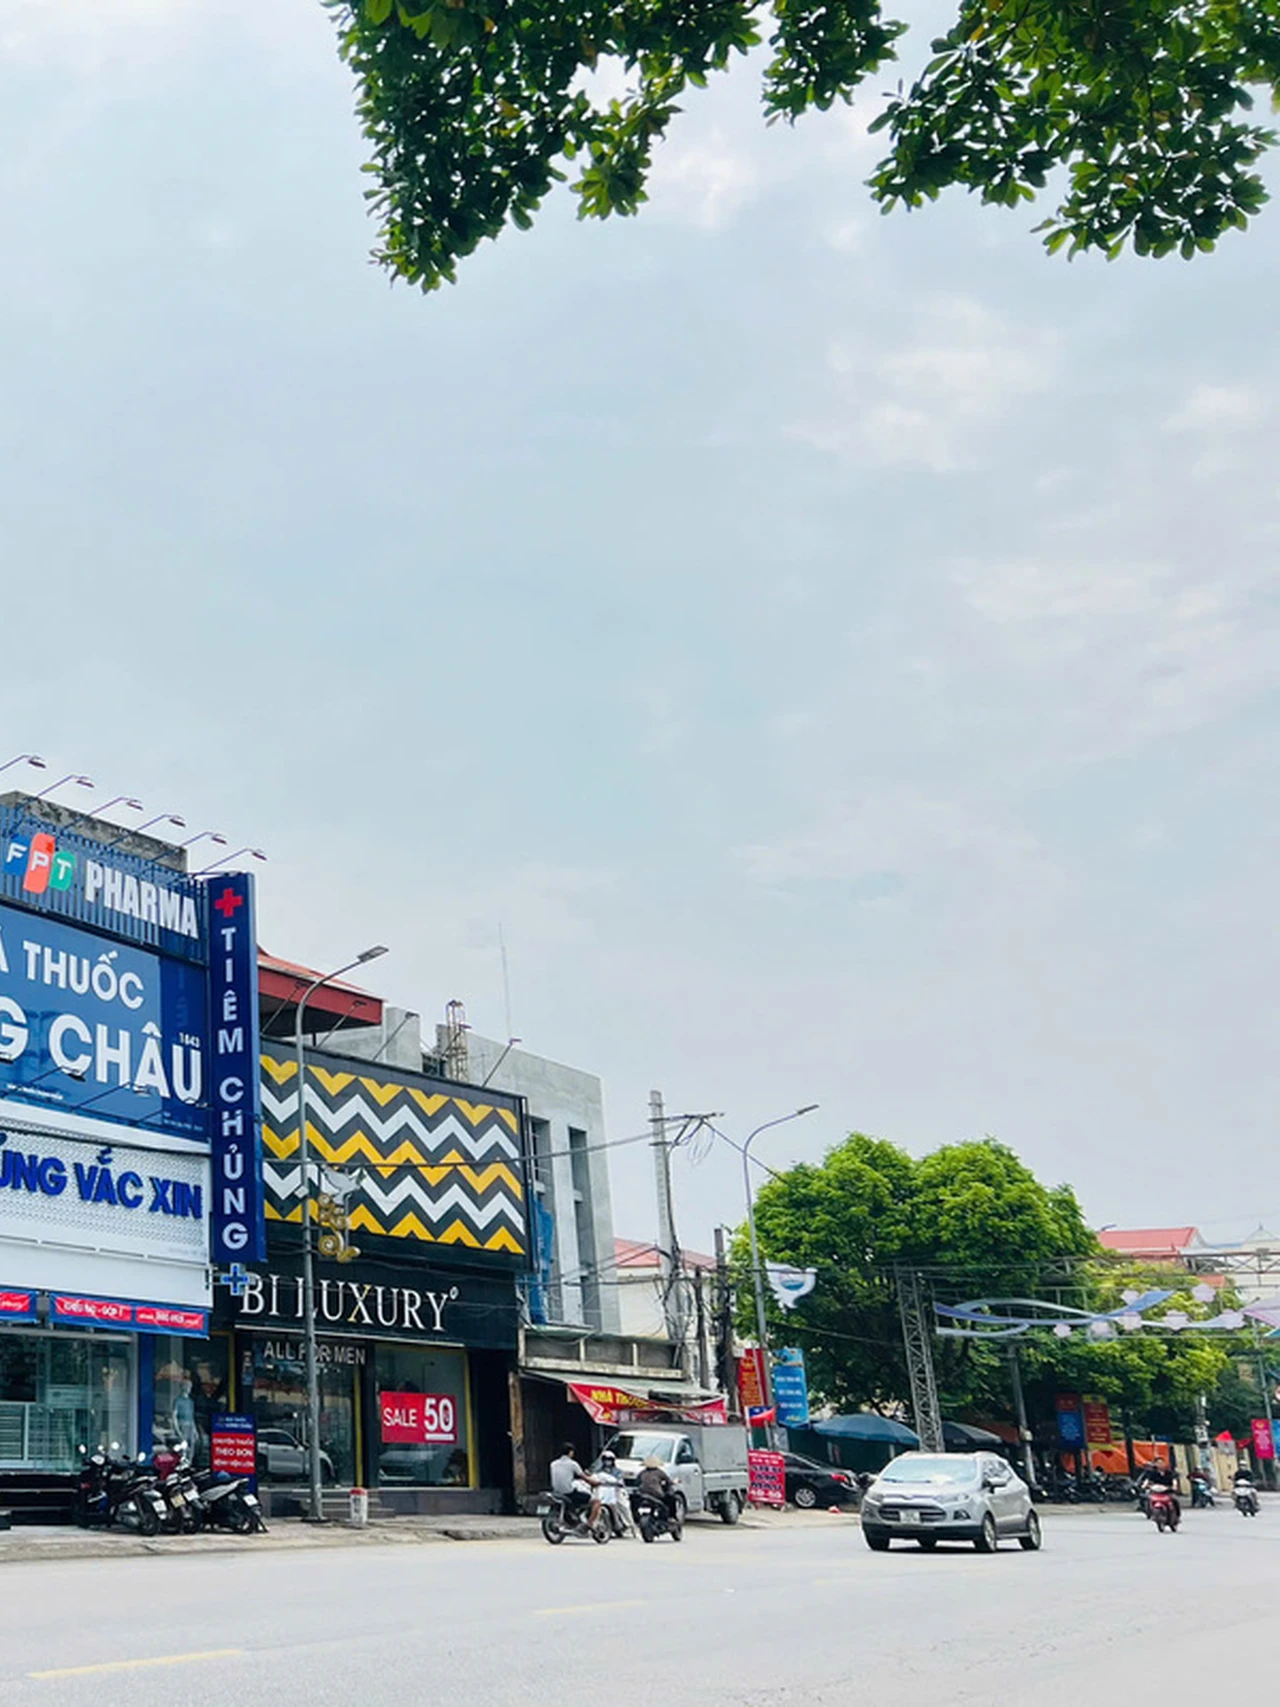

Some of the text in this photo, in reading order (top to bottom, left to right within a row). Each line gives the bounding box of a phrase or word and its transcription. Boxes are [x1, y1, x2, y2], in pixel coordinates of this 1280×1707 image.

[5, 842, 74, 884] FPT
[85, 859, 199, 939] PHARMA
[22, 939, 144, 1010] THUỐC
[49, 1014, 202, 1105] CHÂU
[74, 1148, 144, 1208] VẮC
[150, 1177, 202, 1219] XIN
[240, 1273, 280, 1316] BI
[263, 1341, 366, 1365] ALL FR MEN
[384, 1407, 417, 1428] SALE
